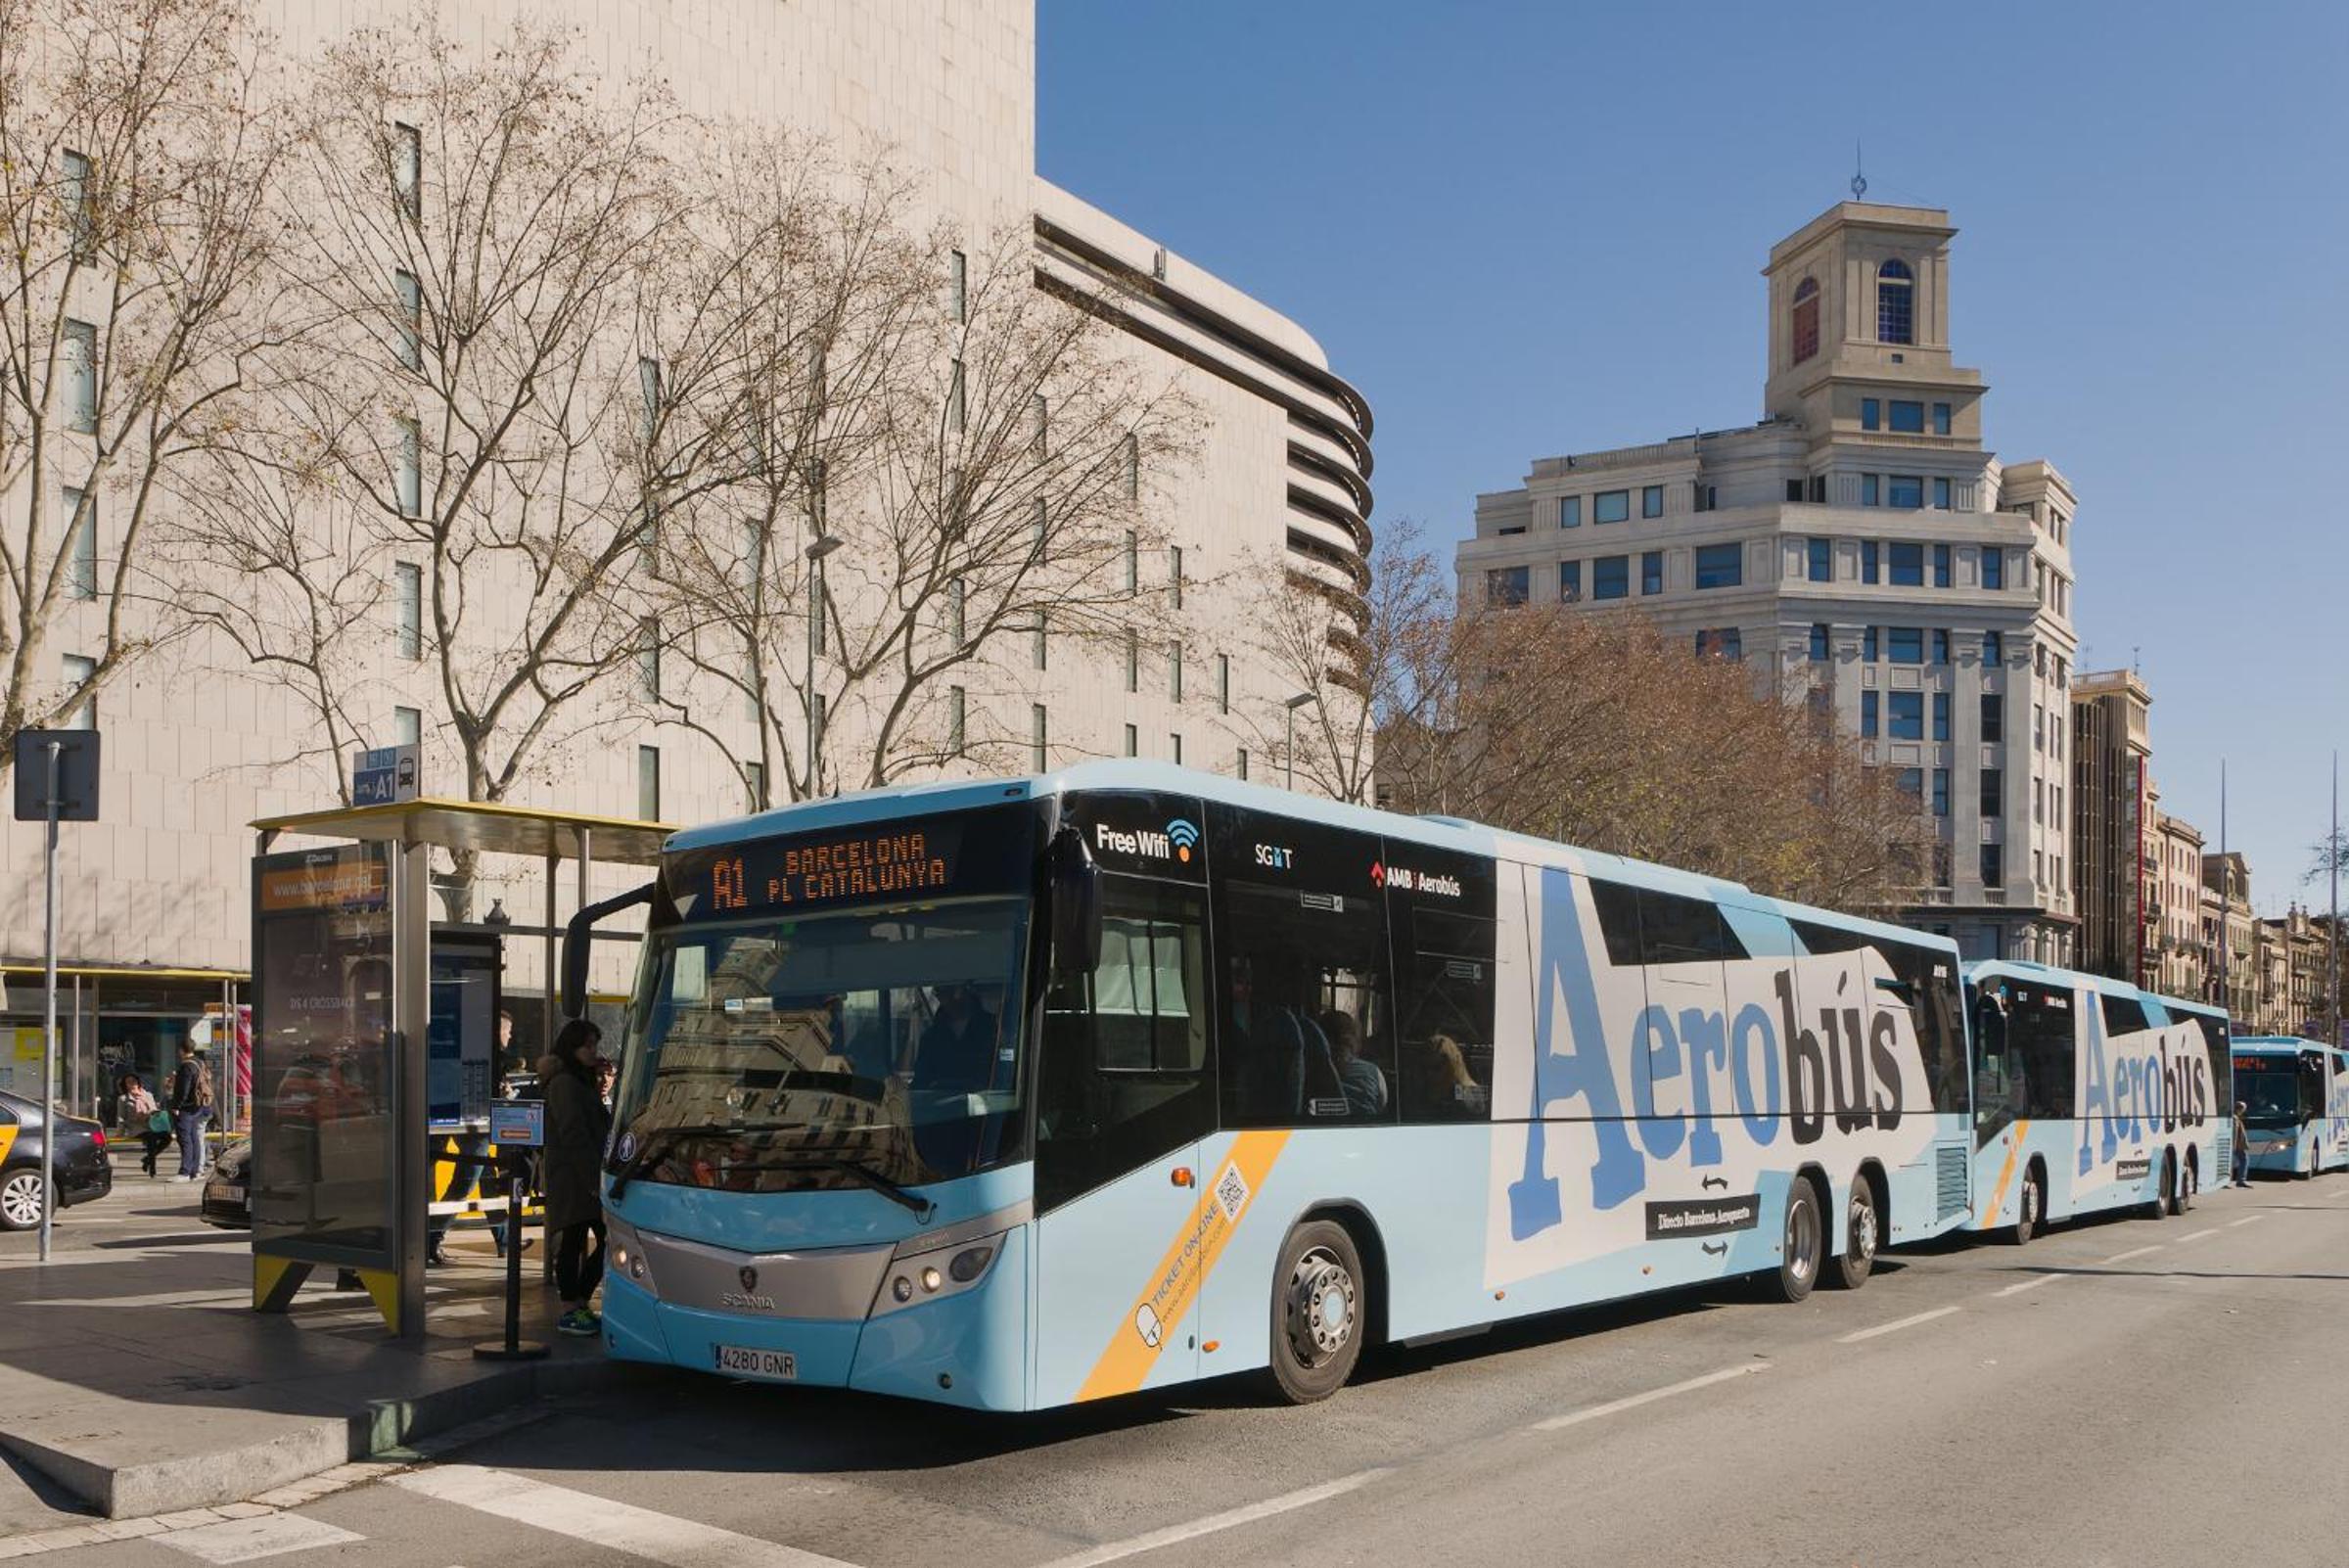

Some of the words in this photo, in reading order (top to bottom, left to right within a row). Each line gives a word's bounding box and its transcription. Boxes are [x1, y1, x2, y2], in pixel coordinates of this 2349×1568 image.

[376, 772, 394, 799] A1
[786, 834, 925, 875] BARCELONA
[1096, 824, 1136, 854] Free
[1137, 830, 1171, 859] Wifi
[713, 857, 748, 909] A1
[767, 878, 793, 902] PL
[806, 858, 944, 899] CATALUNYA
[1387, 867, 1413, 890] AMB
[1419, 872, 1461, 898] Aerobús
[1507, 865, 1903, 1242] Aerobús
[2079, 991, 2206, 1177] Aerobús
[719, 1293, 776, 1310] SCANIA
[1151, 1256, 1184, 1307] TICKET
[723, 1350, 759, 1370] 4280
[763, 1355, 793, 1377] GNR
